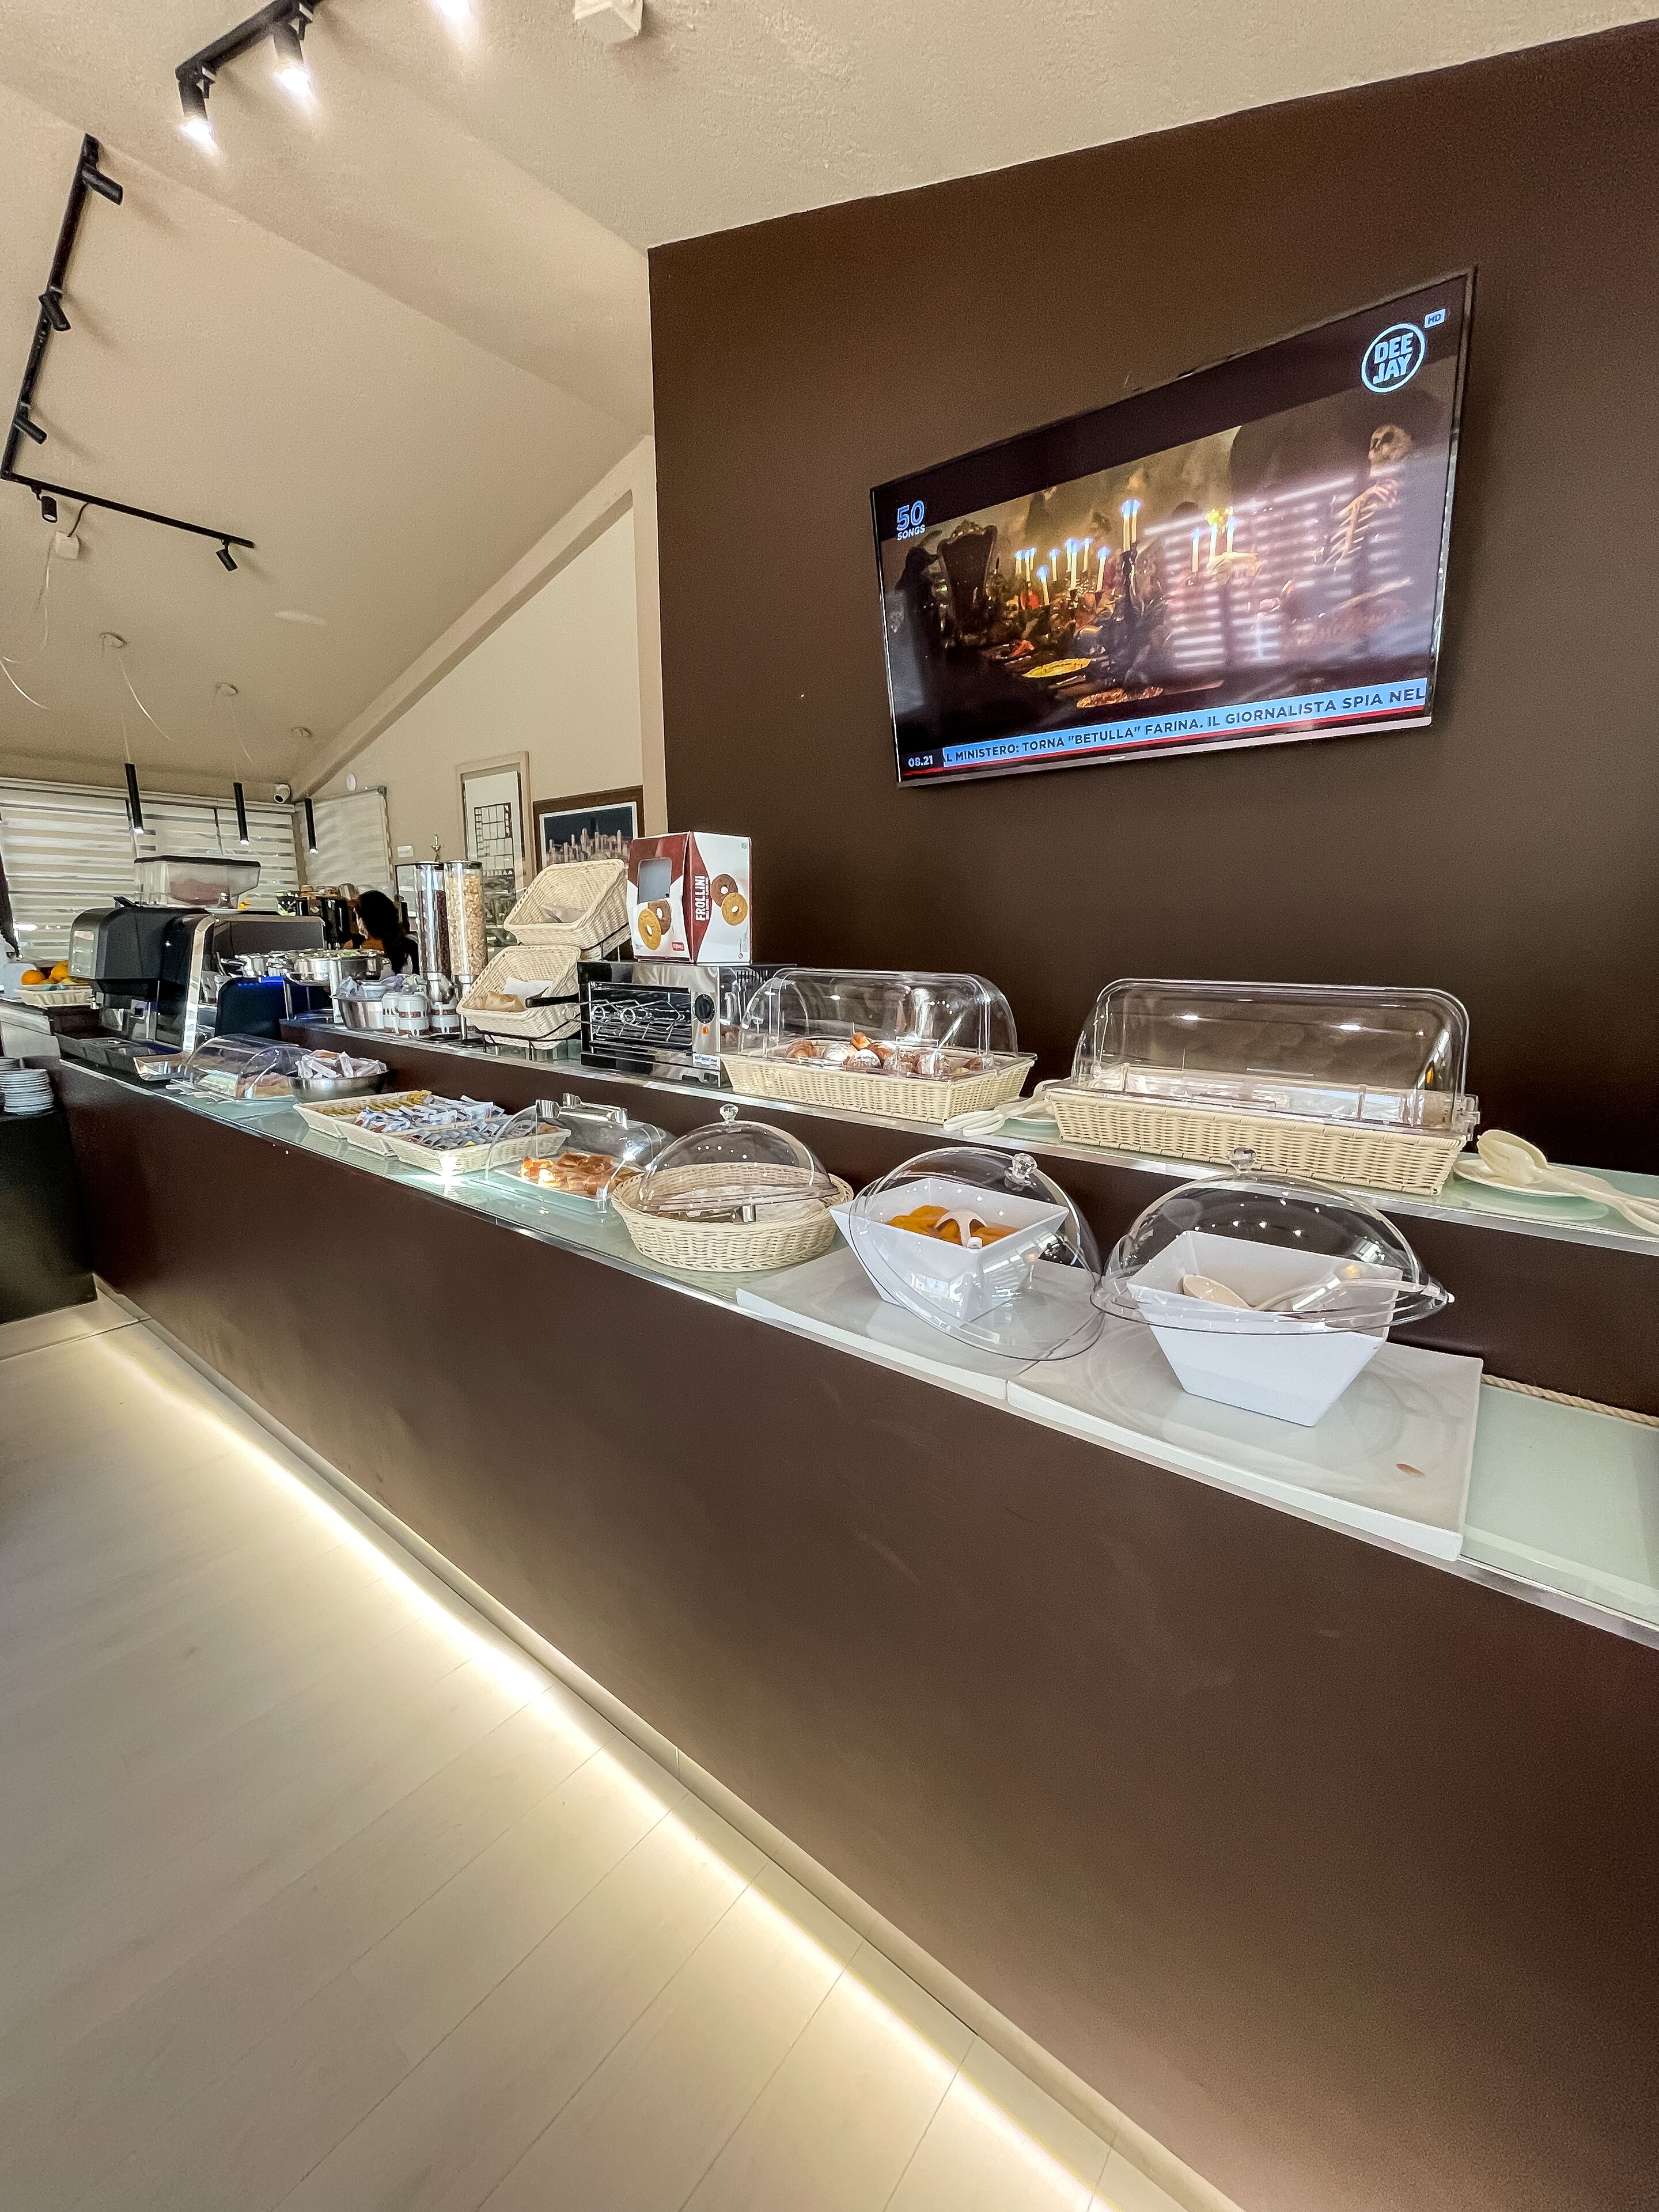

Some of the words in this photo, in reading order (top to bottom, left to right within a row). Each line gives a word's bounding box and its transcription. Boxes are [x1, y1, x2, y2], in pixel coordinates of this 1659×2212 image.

[1427, 314, 1441, 324] HD
[1374, 332, 1414, 364] DEE
[1373, 354, 1412, 384] JAY
[896, 500, 925, 531] 50
[897, 524, 925, 540] SONGS
[955, 744, 1020, 761] MINISTERO:
[1022, 737, 1065, 750] TORNA
[1068, 726, 1141, 745] "BETULLA"
[1145, 719, 1203, 736] FARINA.
[1208, 715, 1220, 727] IL
[1226, 700, 1336, 724] GIORNALISTA
[1342, 694, 1383, 709] SPIA
[1389, 687, 1425, 703] NEL
[908, 755, 933, 767] 08.21
[695, 876, 706, 921] FROLLINI
